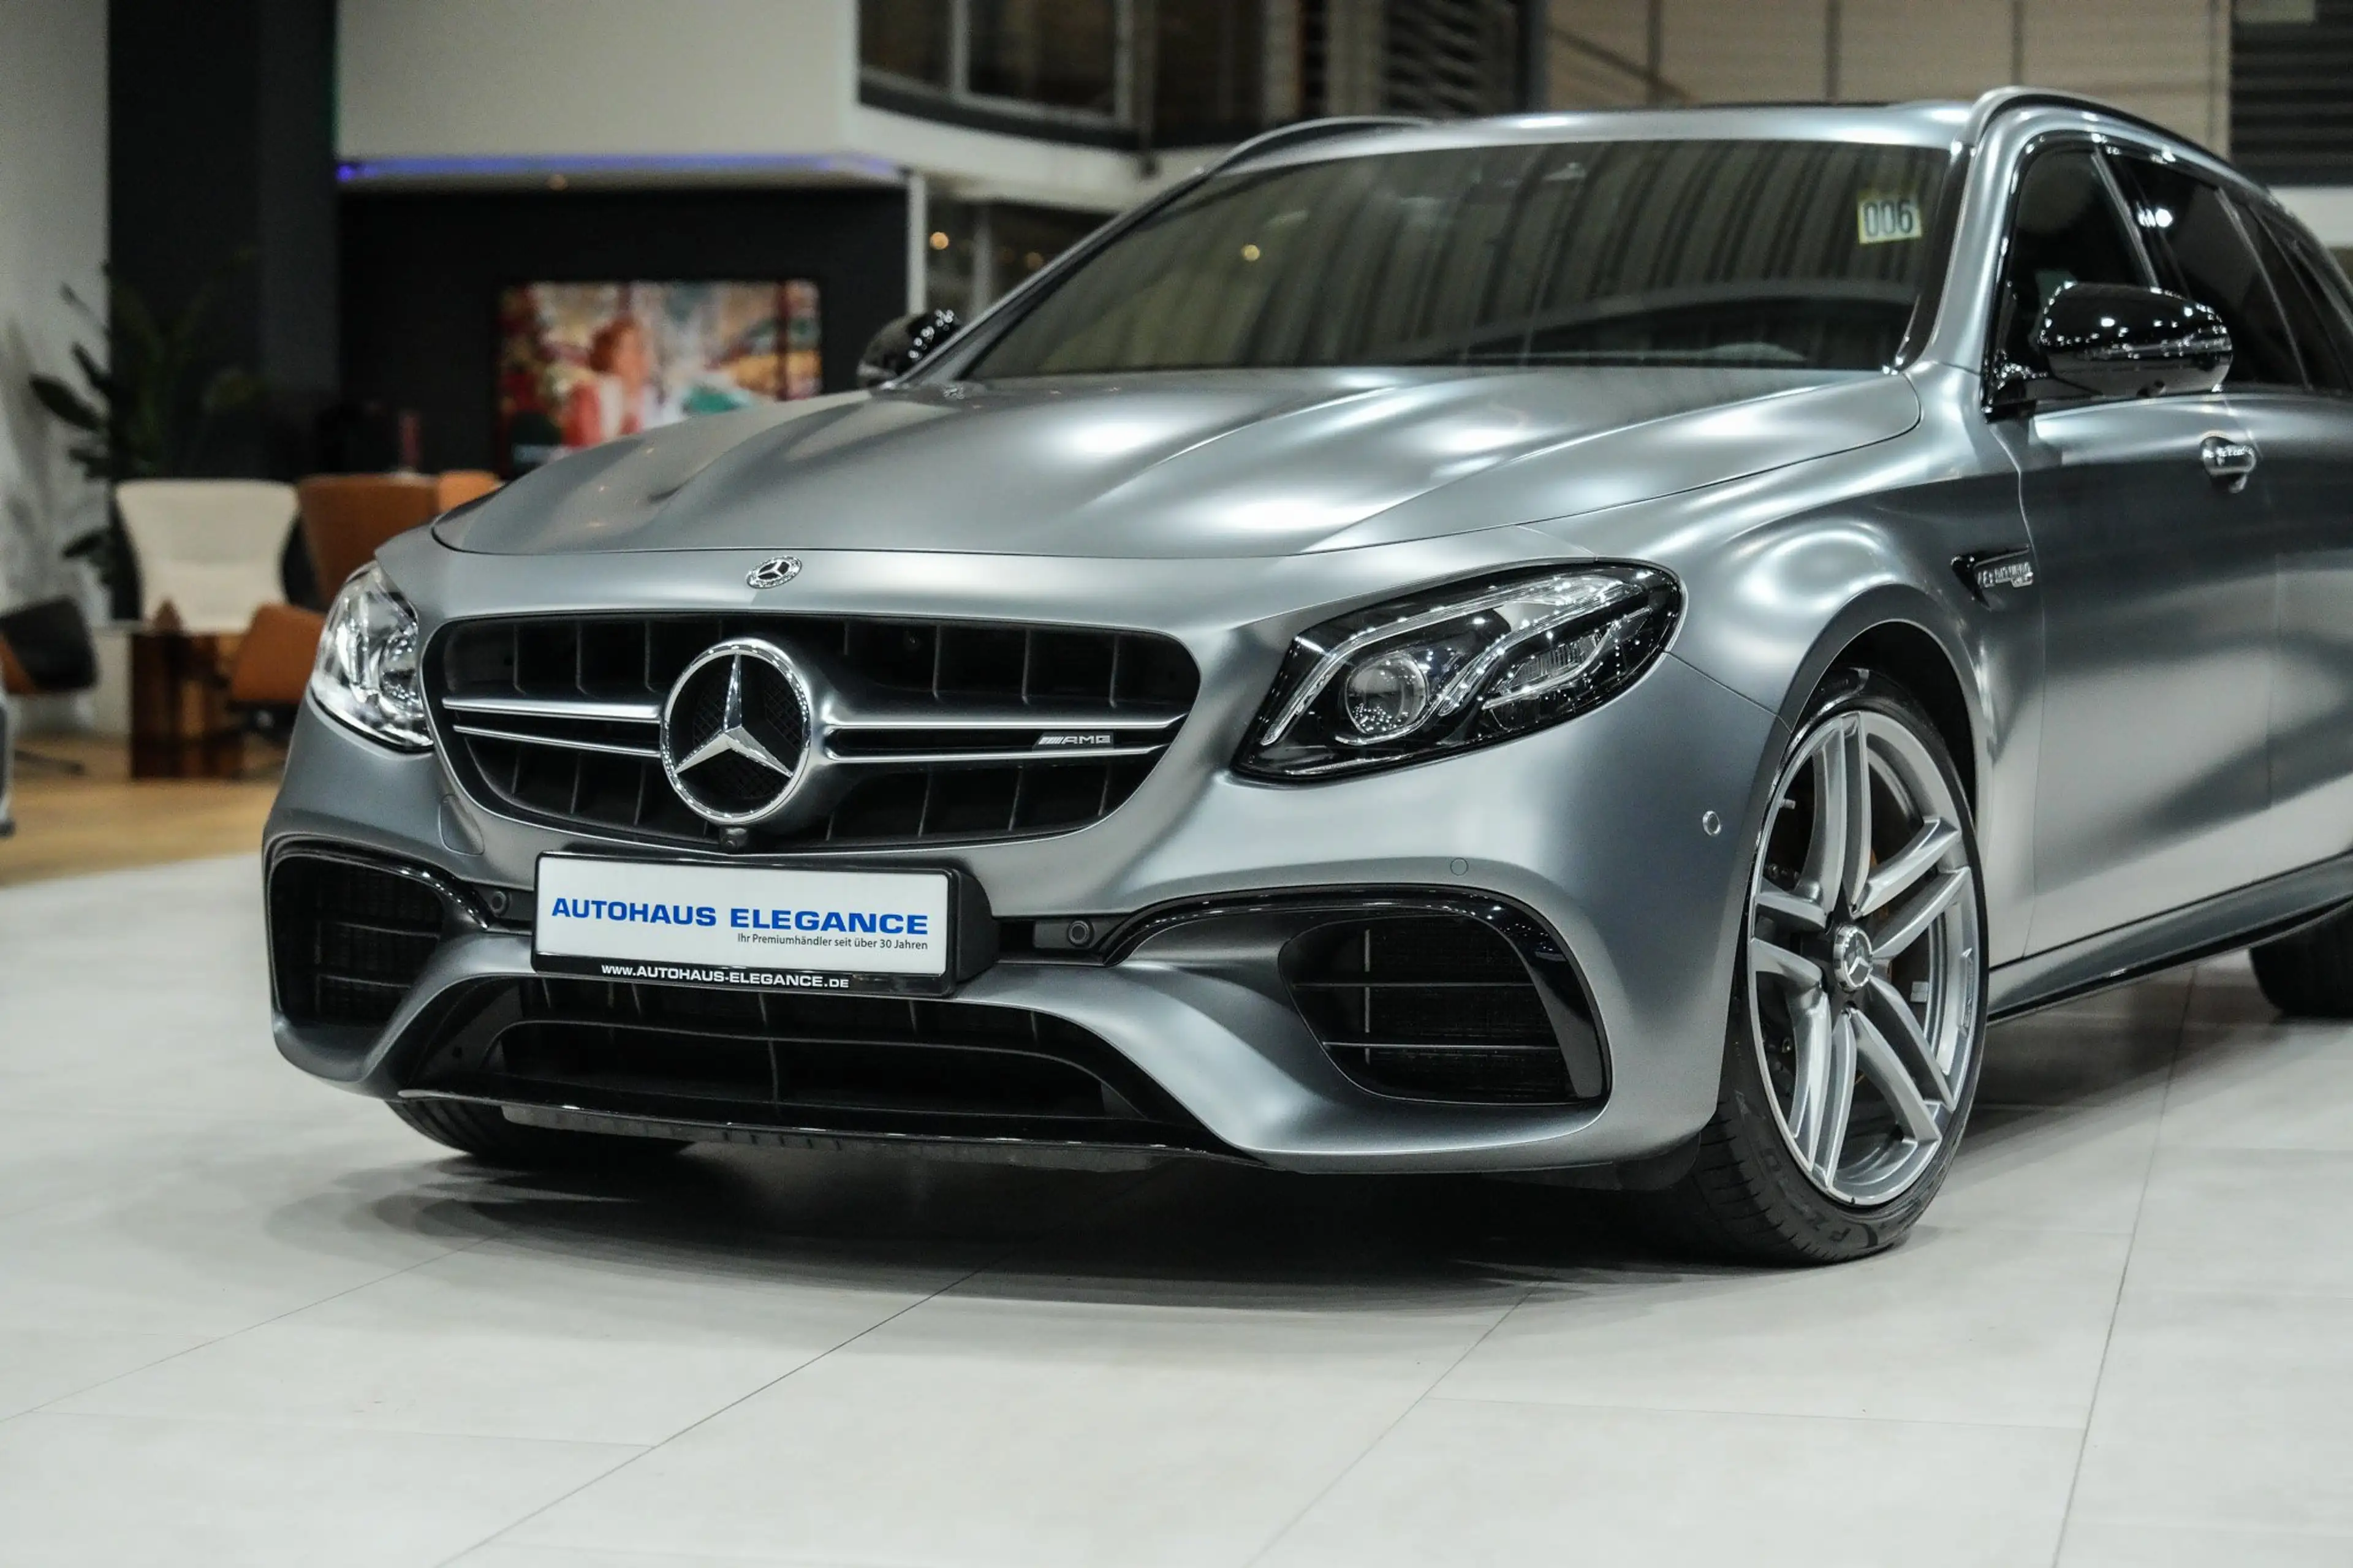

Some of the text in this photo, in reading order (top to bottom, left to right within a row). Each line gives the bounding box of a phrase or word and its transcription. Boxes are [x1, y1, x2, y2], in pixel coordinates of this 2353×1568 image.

[1061, 735, 1111, 744] AMG
[552, 898, 928, 935] AUTOHAUS ELEGANCE
[737, 933, 928, 950] Ihr Premiumhändler seit über 30 Jahren
